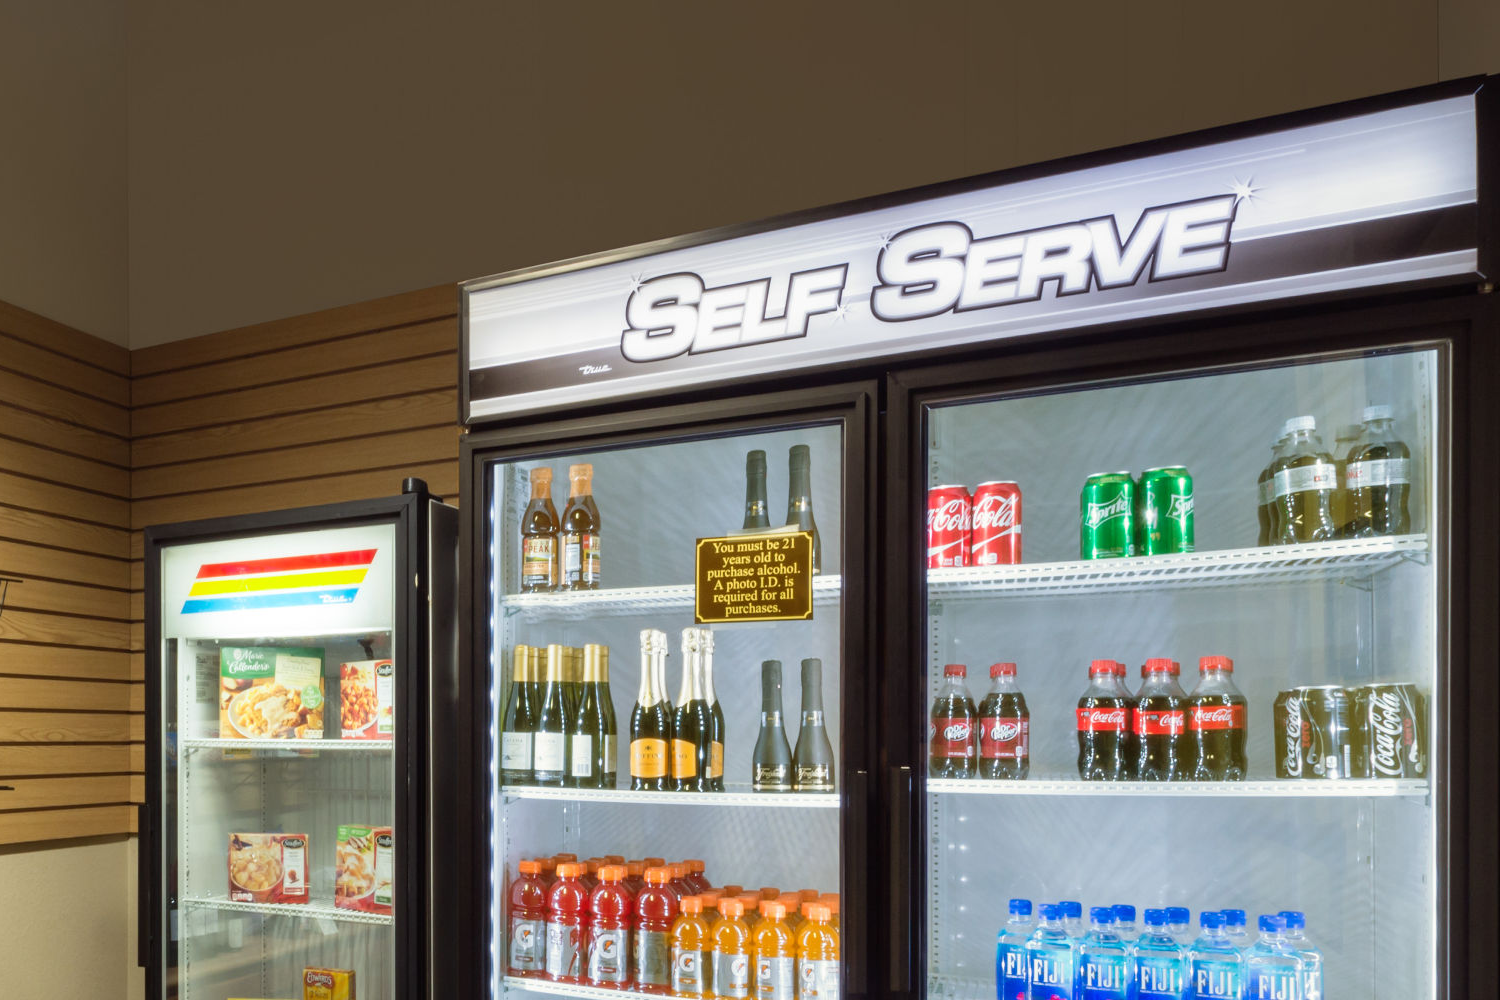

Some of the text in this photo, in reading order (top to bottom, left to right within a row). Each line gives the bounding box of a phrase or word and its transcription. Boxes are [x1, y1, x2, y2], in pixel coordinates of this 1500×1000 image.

[620, 194, 1242, 363] SELF SERVE
[1089, 501, 1130, 525] Sprite
[528, 545, 549, 553] PEAK
[713, 538, 795, 553] You must be 21
[722, 552, 785, 568] years old to
[707, 562, 801, 581] purchase alcohol.
[713, 576, 794, 592] A photo I.D. is
[713, 588, 794, 605] required for all
[725, 603, 782, 617] purchases.
[1286, 696, 1302, 777] Coca-Cola
[1370, 691, 1403, 776] Coca-Cola
[306, 971, 333, 986] EDWARDS
[1033, 958, 1065, 985] FIJI
[1086, 962, 1122, 989] FIJI
[1140, 965, 1176, 993] FIJI
[1197, 969, 1235, 997] FIJI
